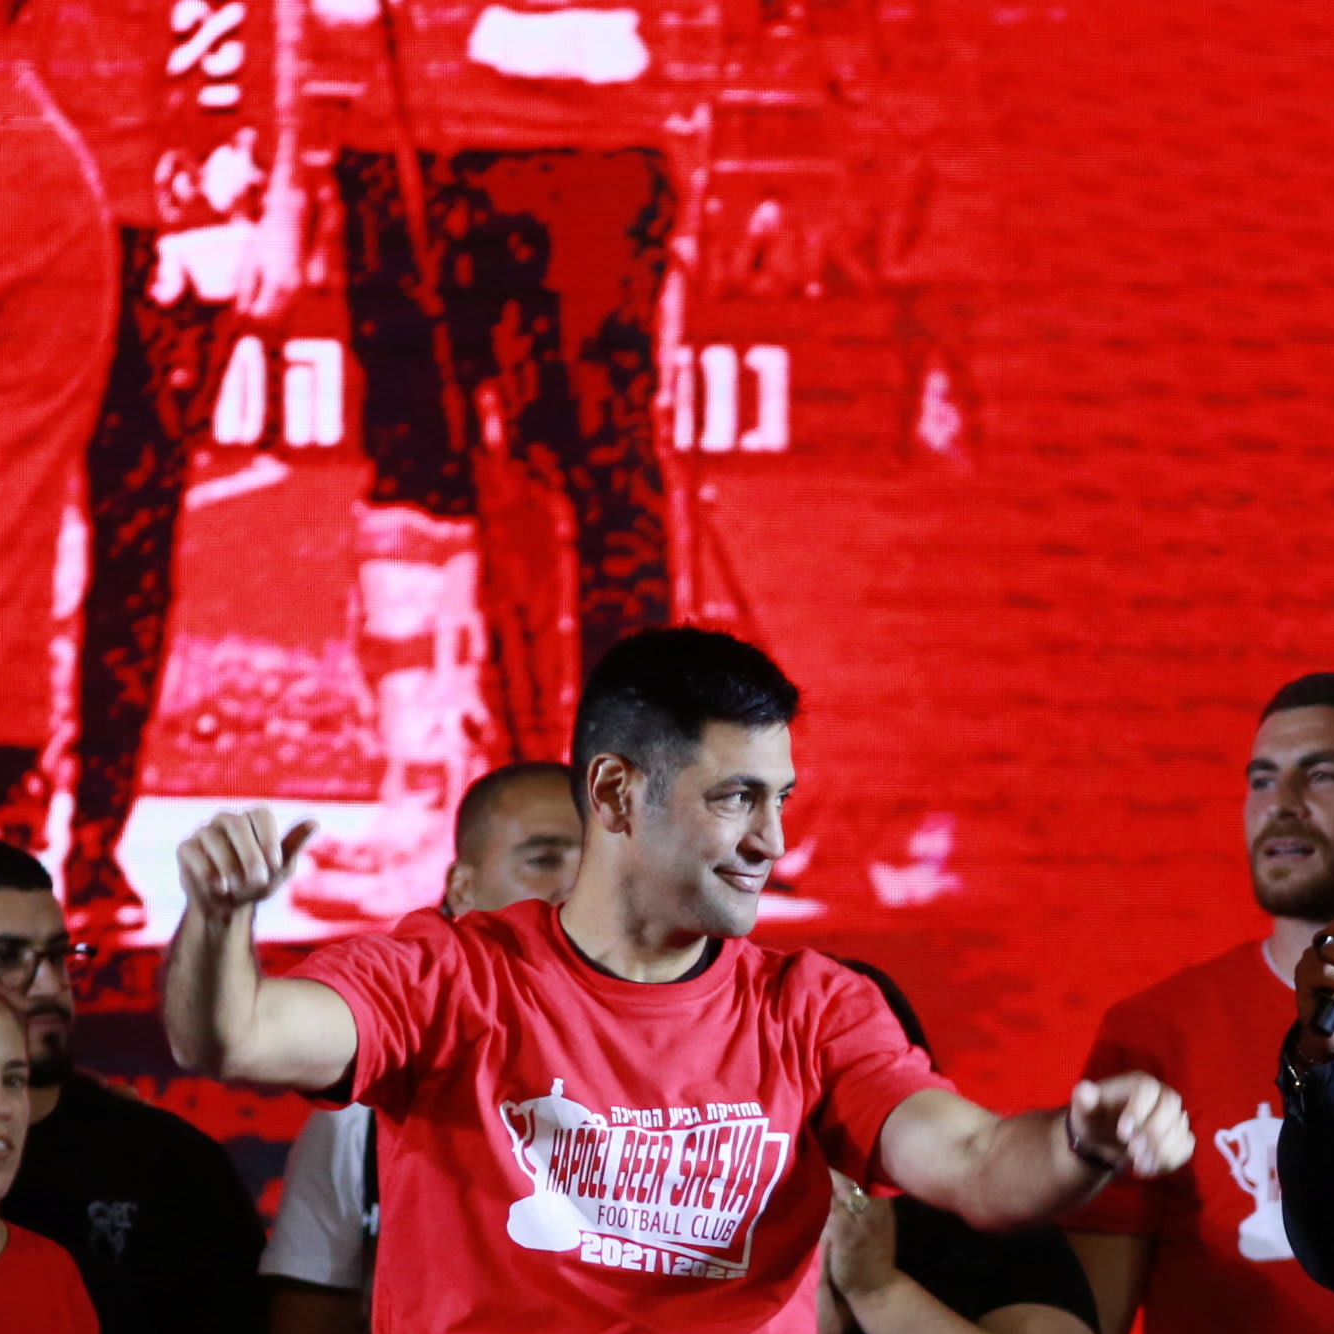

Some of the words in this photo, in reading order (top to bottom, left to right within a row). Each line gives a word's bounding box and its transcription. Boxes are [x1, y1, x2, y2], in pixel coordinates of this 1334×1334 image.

[610, 1106, 664, 1128] המדינה
[668, 1106, 702, 1128] גביע
[706, 1102, 764, 1122] מחזיקת
[546, 1127, 613, 1199] HAPOEL
[613, 1129, 674, 1205] BEER
[670, 1124, 764, 1214] SHEVA
[597, 1205, 682, 1236] FOOTBALL
[691, 1214, 737, 1241] CLUB
